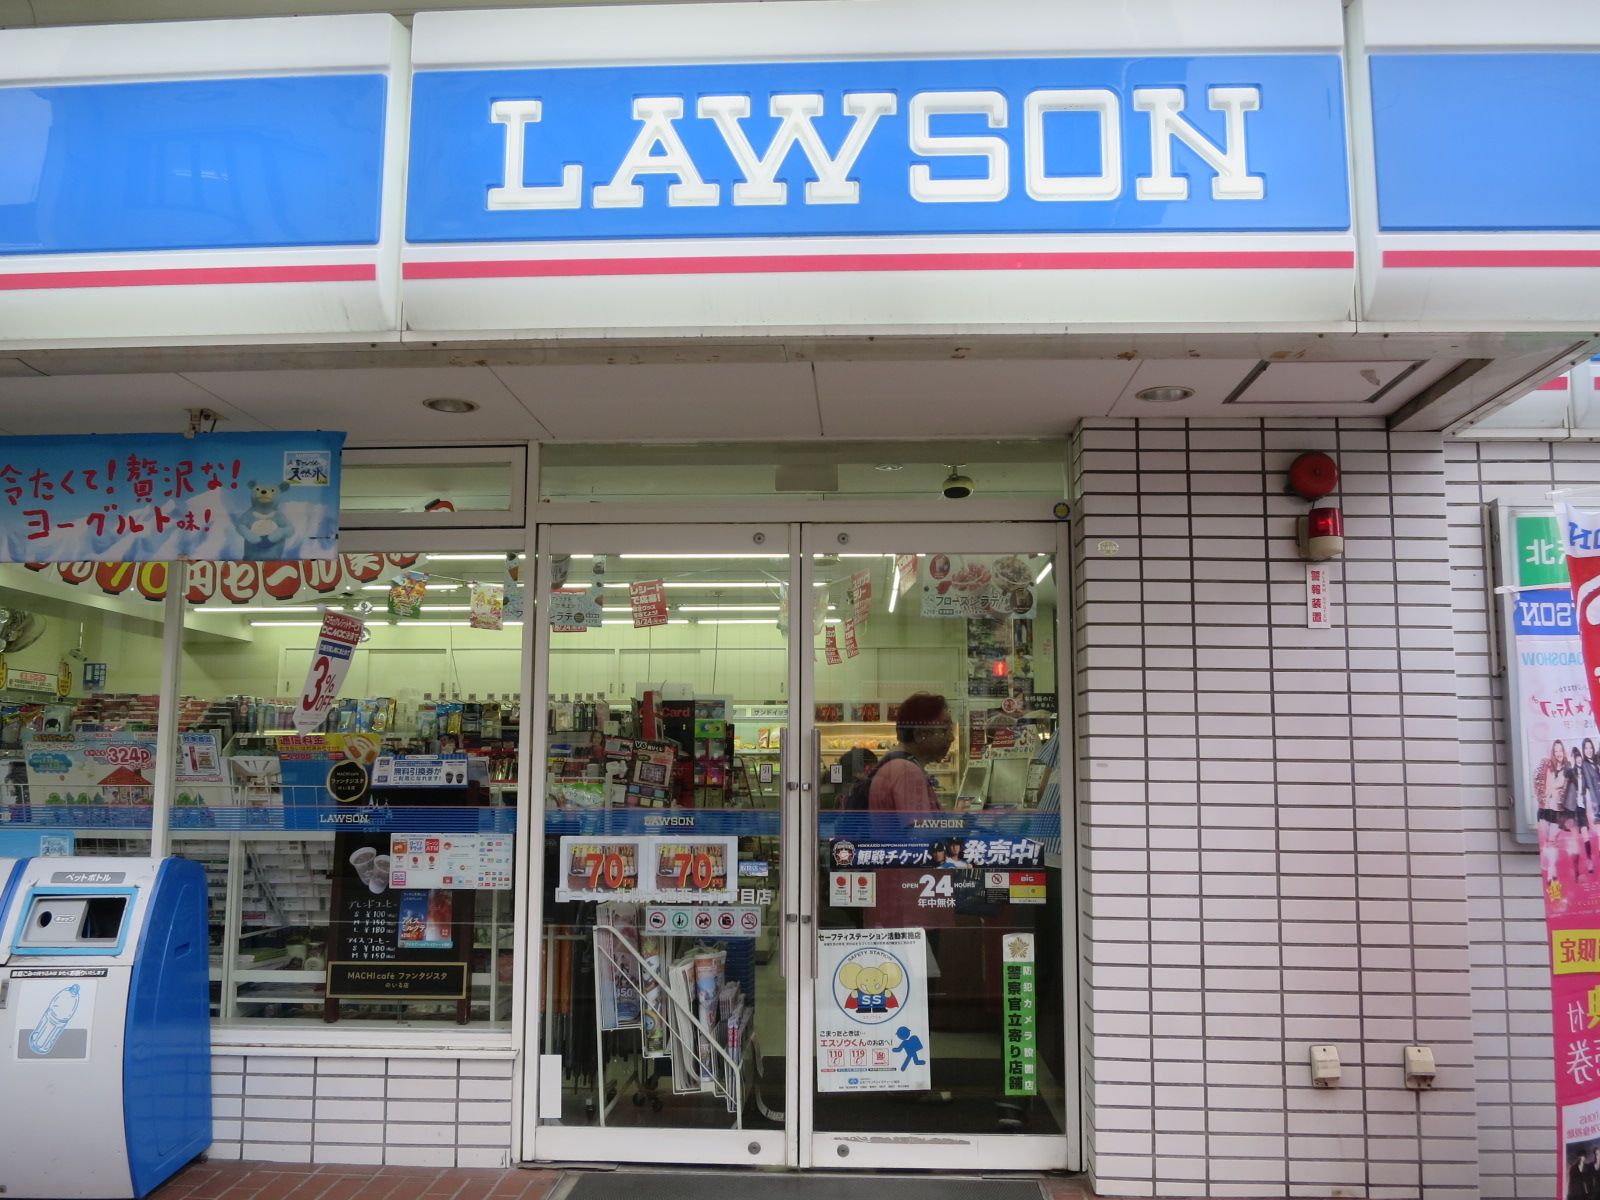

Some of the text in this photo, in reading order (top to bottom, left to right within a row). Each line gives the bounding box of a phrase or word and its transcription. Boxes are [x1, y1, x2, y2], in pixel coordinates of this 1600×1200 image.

[487, 87, 1264, 210] LAWSON
[23, 504, 212, 540] ヨーグルト味!
[319, 814, 369, 824] LAWSON
[643, 816, 695, 826] LAWSON
[913, 819, 964, 829] LAWSON
[857, 849, 933, 866] 観戦チケット
[962, 838, 1040, 867] 発売中!
[64, 873, 112, 883] ペットボトル
[919, 873, 953, 897] 24
[954, 880, 976, 889] HOURS
[917, 897, 957, 908] 年中無休
[818, 931, 921, 943] セーフティステーション活動実施店
[847, 950, 868, 962] SAFETY
[347, 971, 375, 980] MACHI
[398, 971, 448, 981] ファンタジスタ
[861, 995, 882, 1005] SS
[1007, 965, 1023, 1092] 警察官立寄り店舗
[829, 1050, 843, 1058] 110
[851, 1050, 865, 1058] 119
